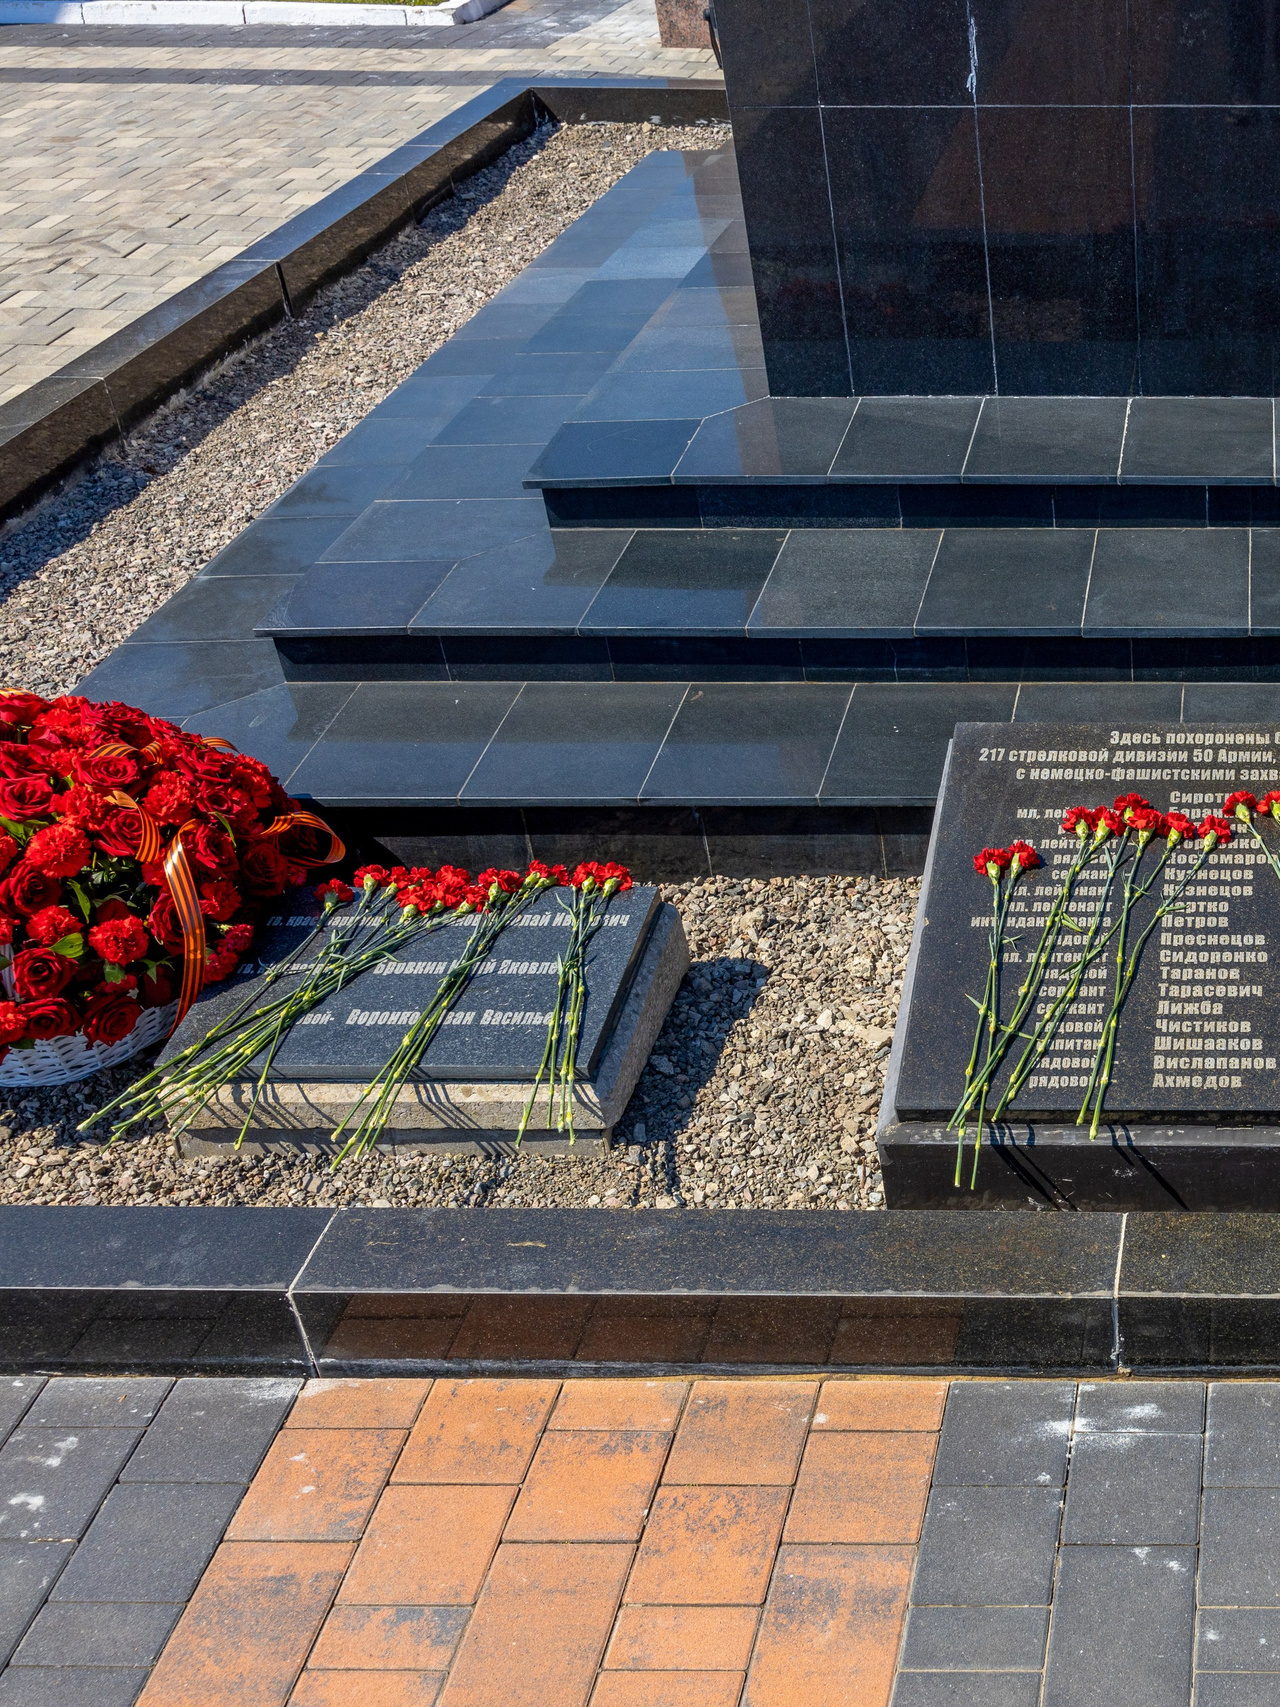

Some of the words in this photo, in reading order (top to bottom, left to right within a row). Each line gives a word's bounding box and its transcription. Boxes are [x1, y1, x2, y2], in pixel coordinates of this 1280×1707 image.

[1110, 730, 1161, 746] Здесь
[1166, 733, 1270, 746] похоронены
[978, 748, 1004, 762] 217
[1008, 748, 1109, 762] стрелковой
[1112, 749, 1189, 763] дивизии
[1193, 748, 1212, 762] 50
[1217, 748, 1277, 764] Армии,
[1016, 769, 1025, 780] с
[1029, 767, 1236, 781] немецко-фашистскими
[1161, 914, 1229, 928] Петров
[1160, 932, 1266, 947] Преснецов
[1159, 950, 1268, 964] Сидоренко
[373, 961, 448, 976] Бровкин
[1159, 966, 1240, 981] Таранов
[1038, 985, 1107, 998] серант
[1158, 983, 1263, 998] Тарасевич
[1157, 1000, 1224, 1015] Лижба
[345, 1008, 431, 1027] Воронко
[1155, 1019, 1252, 1033] Чистиков
[1154, 1036, 1263, 1051] Шишааков
[1032, 1055, 1099, 1070] ядово
[1153, 1054, 1277, 1069] Вислапанов
[1152, 1073, 1243, 1090] Ахмедов
